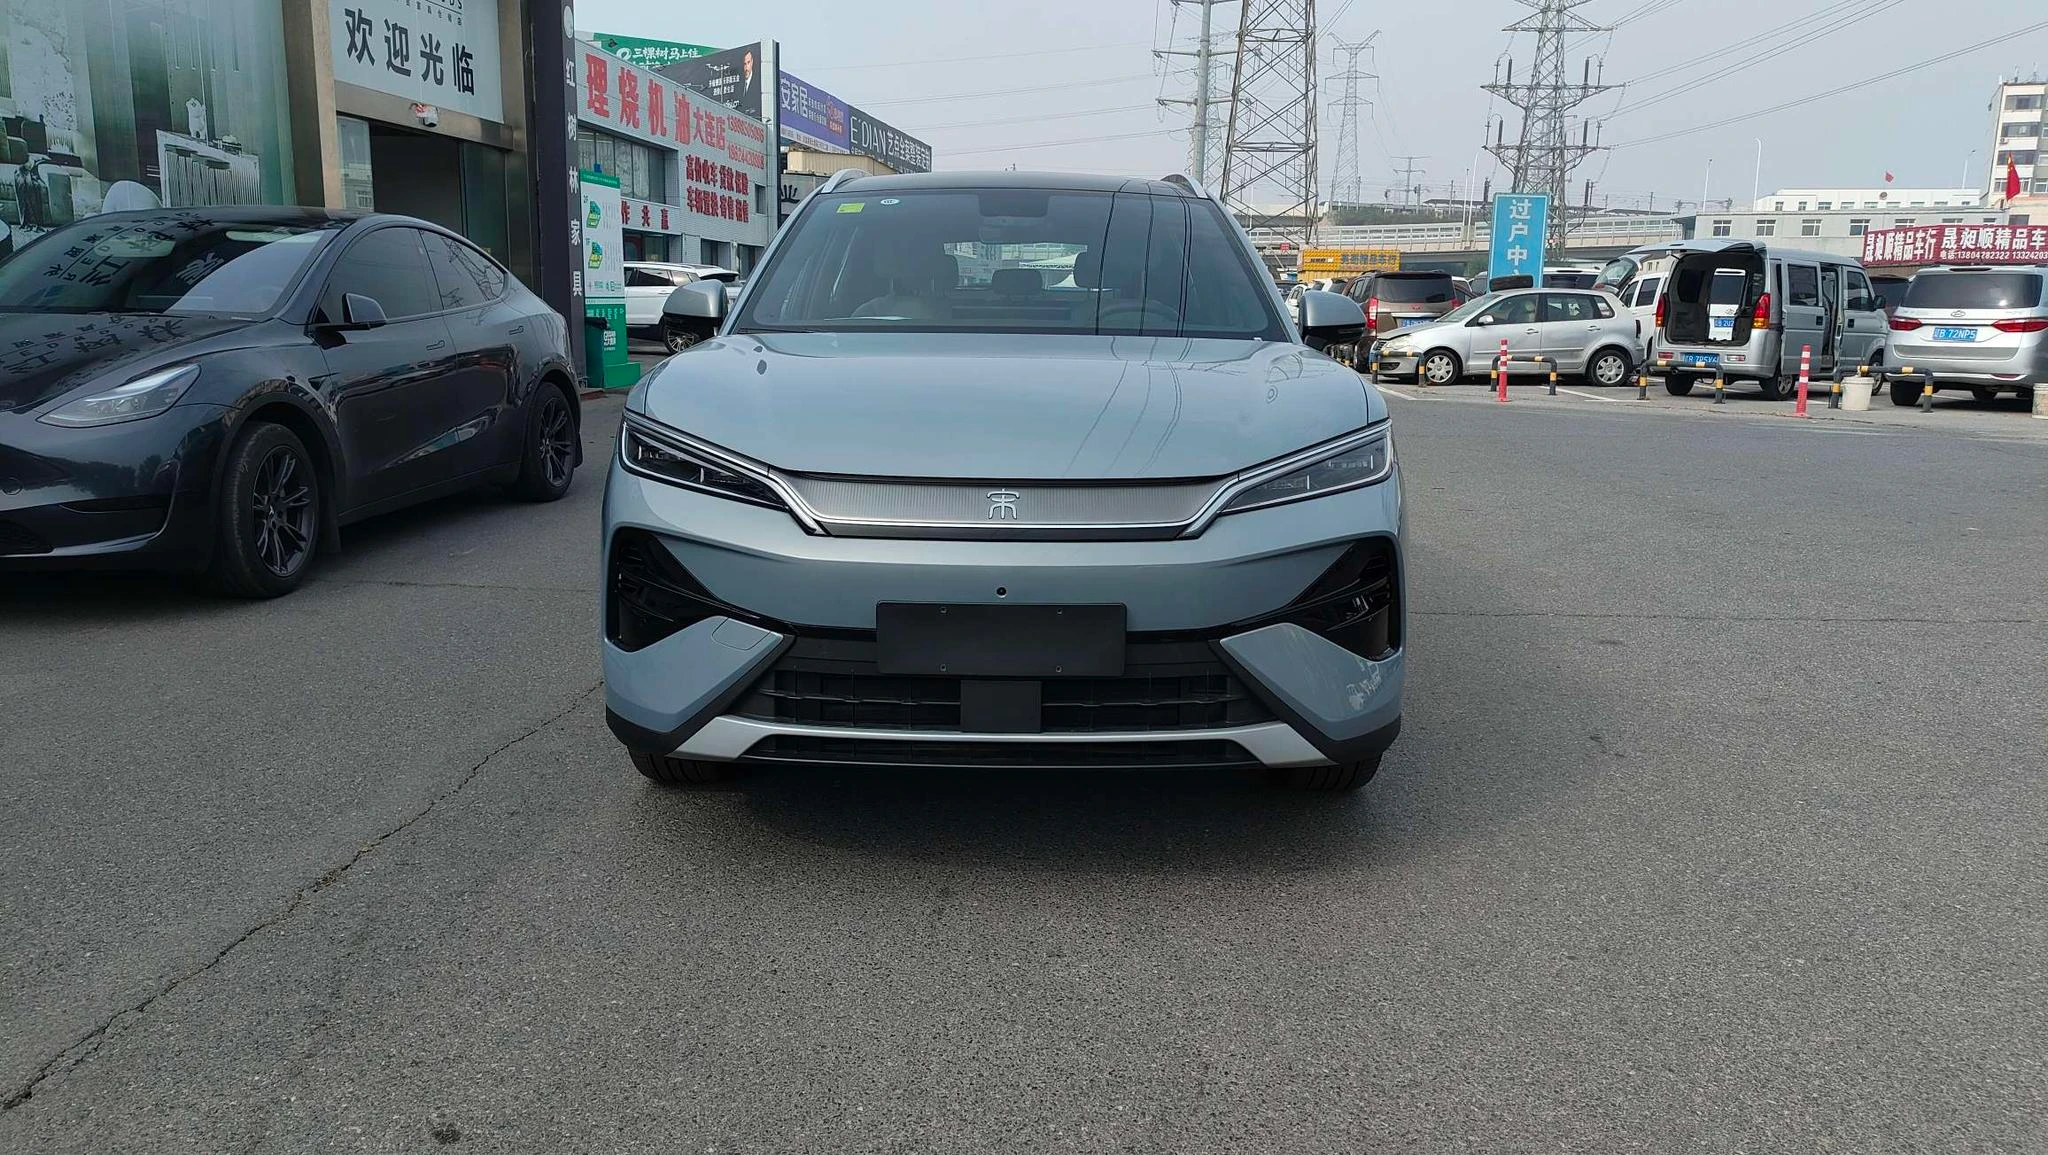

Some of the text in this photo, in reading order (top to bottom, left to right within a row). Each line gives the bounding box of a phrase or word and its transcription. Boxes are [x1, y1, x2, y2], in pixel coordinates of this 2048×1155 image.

[344, 8, 475, 96] 欢迎光临
[565, 58, 582, 296] 红树林家具
[1507, 199, 1532, 275] 过户中
